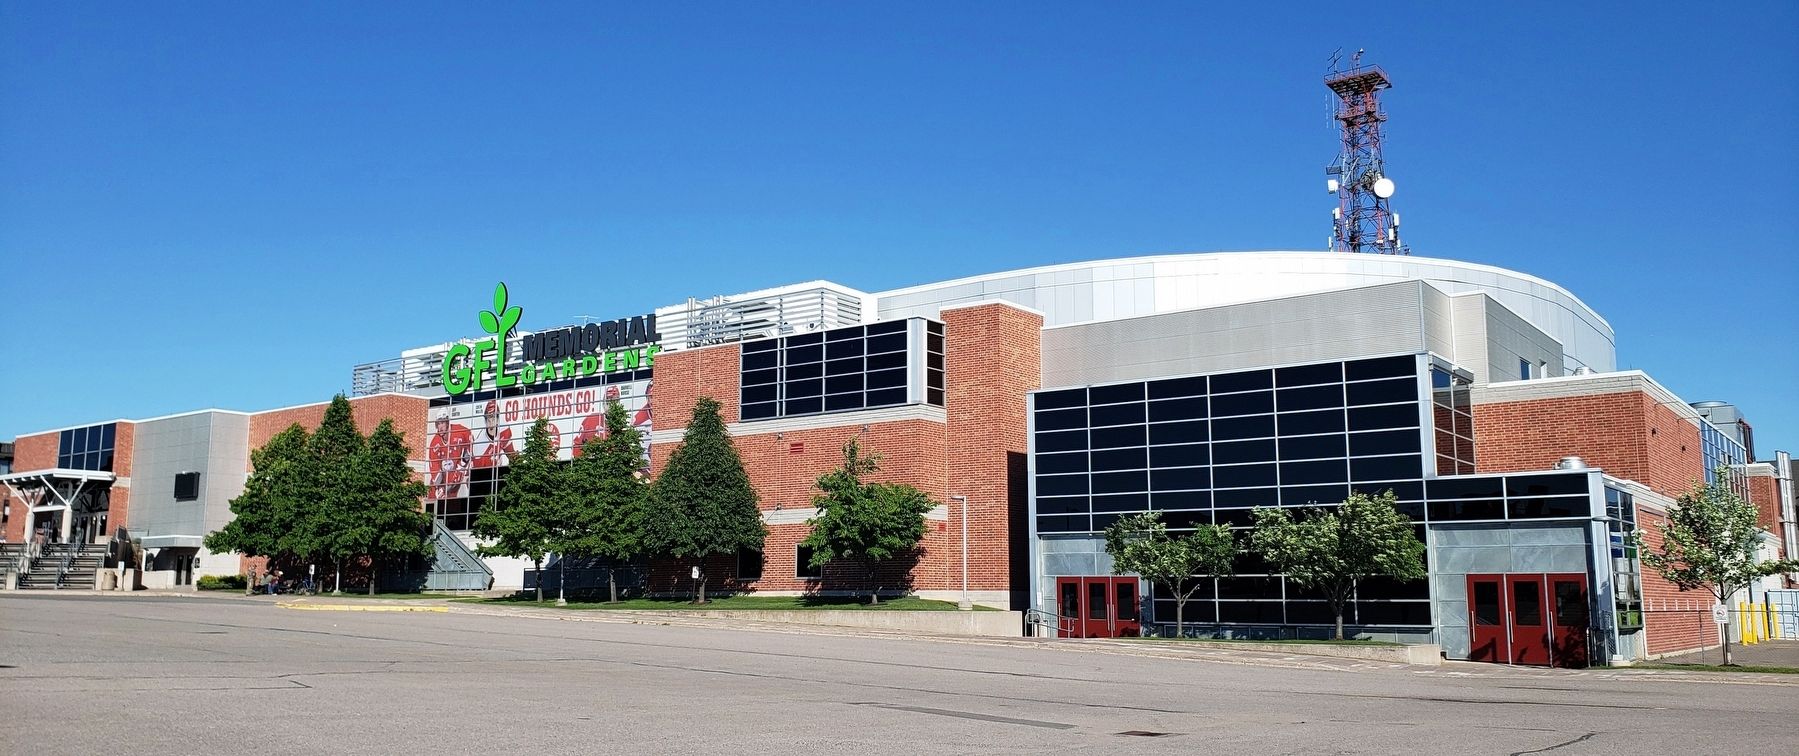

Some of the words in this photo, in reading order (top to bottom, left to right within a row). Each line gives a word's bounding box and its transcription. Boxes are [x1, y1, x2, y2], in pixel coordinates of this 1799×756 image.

[523, 314, 661, 361] MEMORIAL
[443, 325, 516, 395] GFL
[521, 345, 660, 384] GARDENS
[505, 400, 519, 422] GO
[522, 392, 573, 420] HOUNDS
[575, 390, 596, 414] GO!
